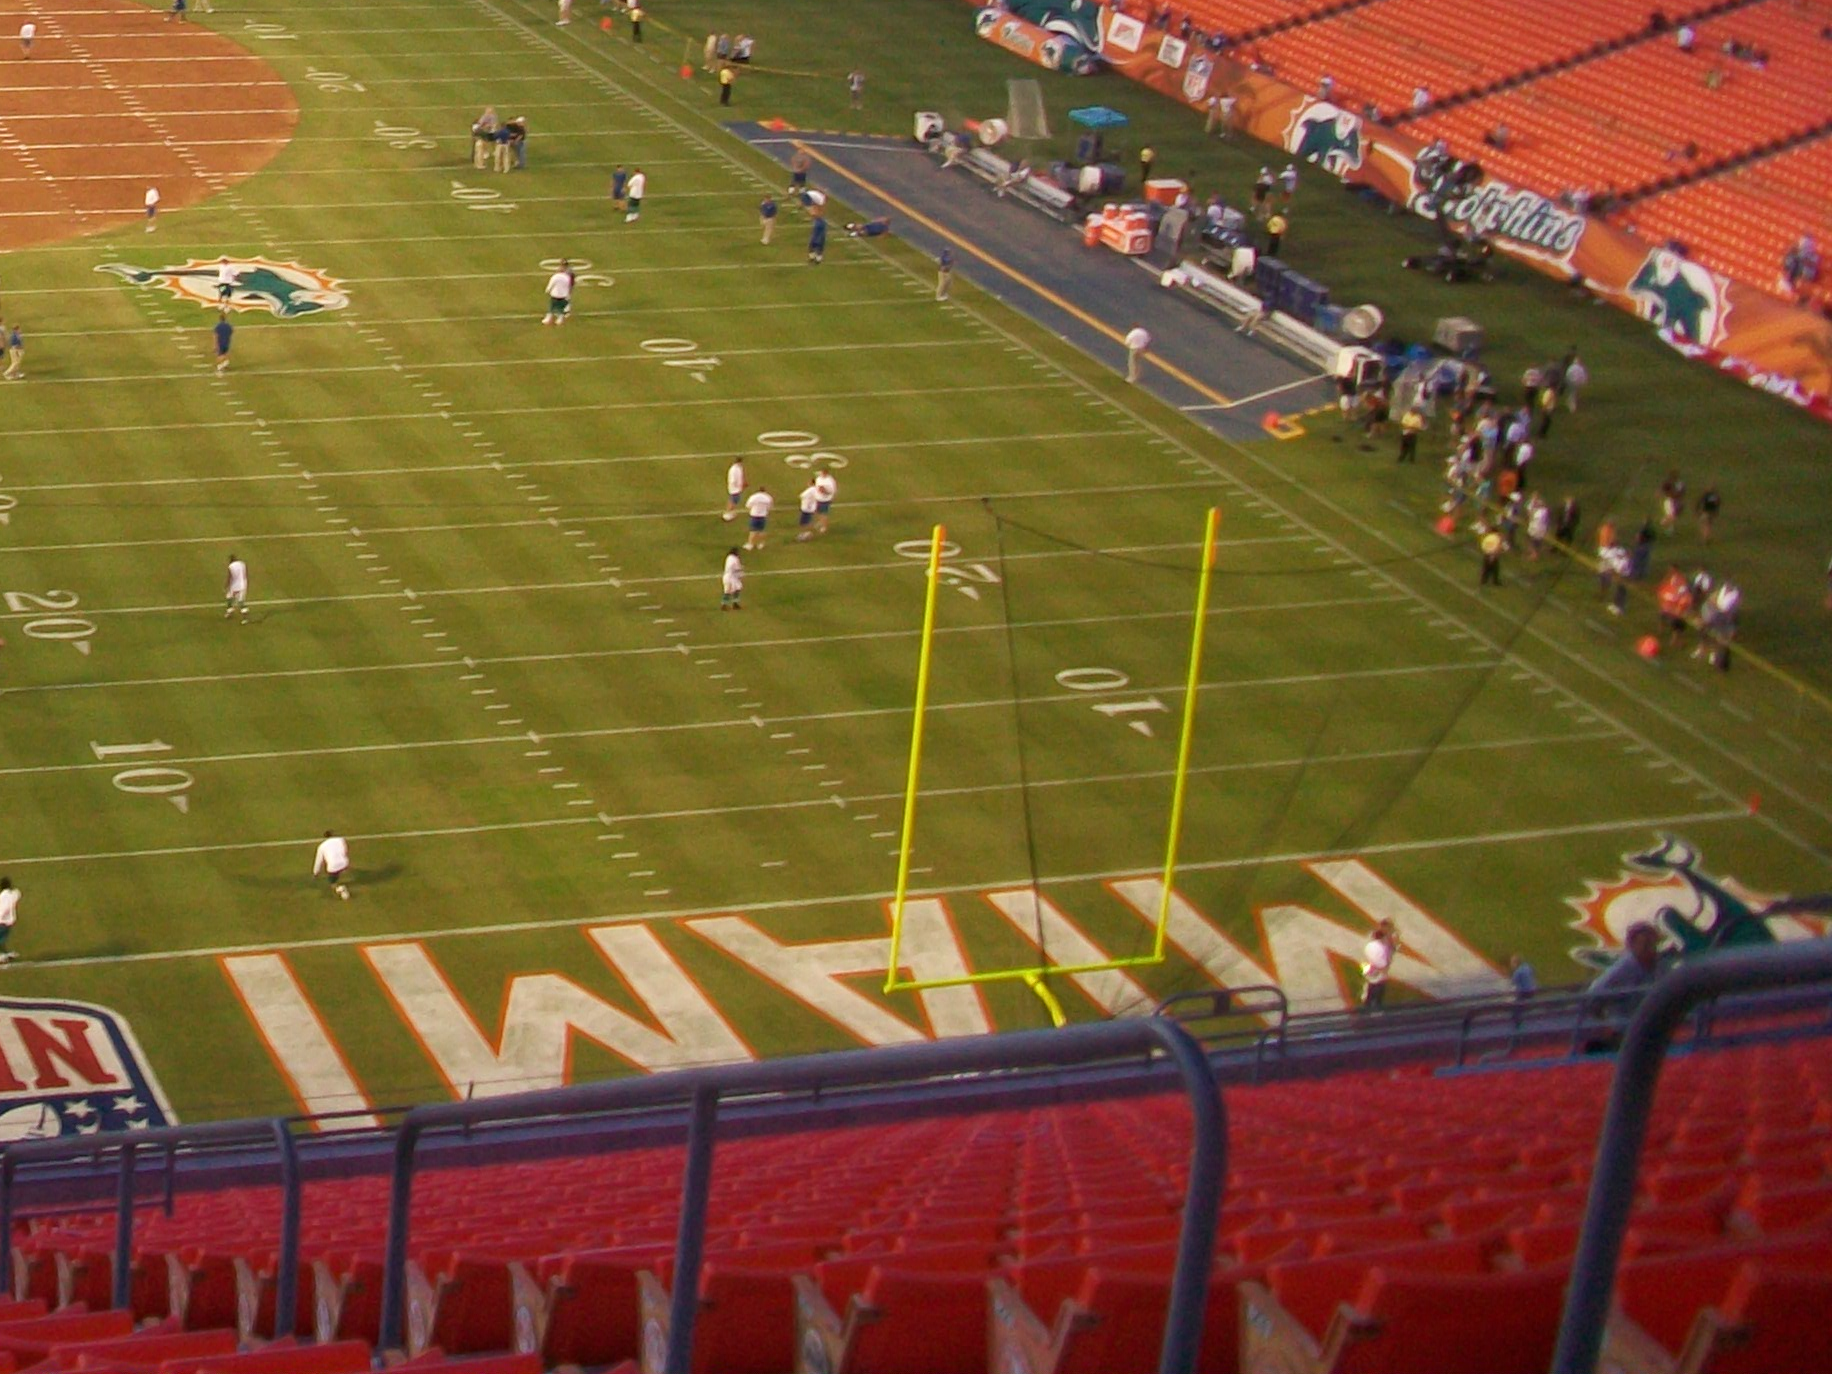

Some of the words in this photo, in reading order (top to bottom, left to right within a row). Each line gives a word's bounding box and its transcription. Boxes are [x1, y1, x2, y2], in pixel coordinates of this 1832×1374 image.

[305, 71, 367, 92] 20
[374, 126, 437, 150] 30
[757, 430, 849, 470] 30
[893, 538, 1001, 586] 20
[4, 589, 98, 640] 20
[1055, 666, 1168, 716] 10
[90, 739, 194, 795] 10
[220, 858, 1516, 1133] MIAMI
